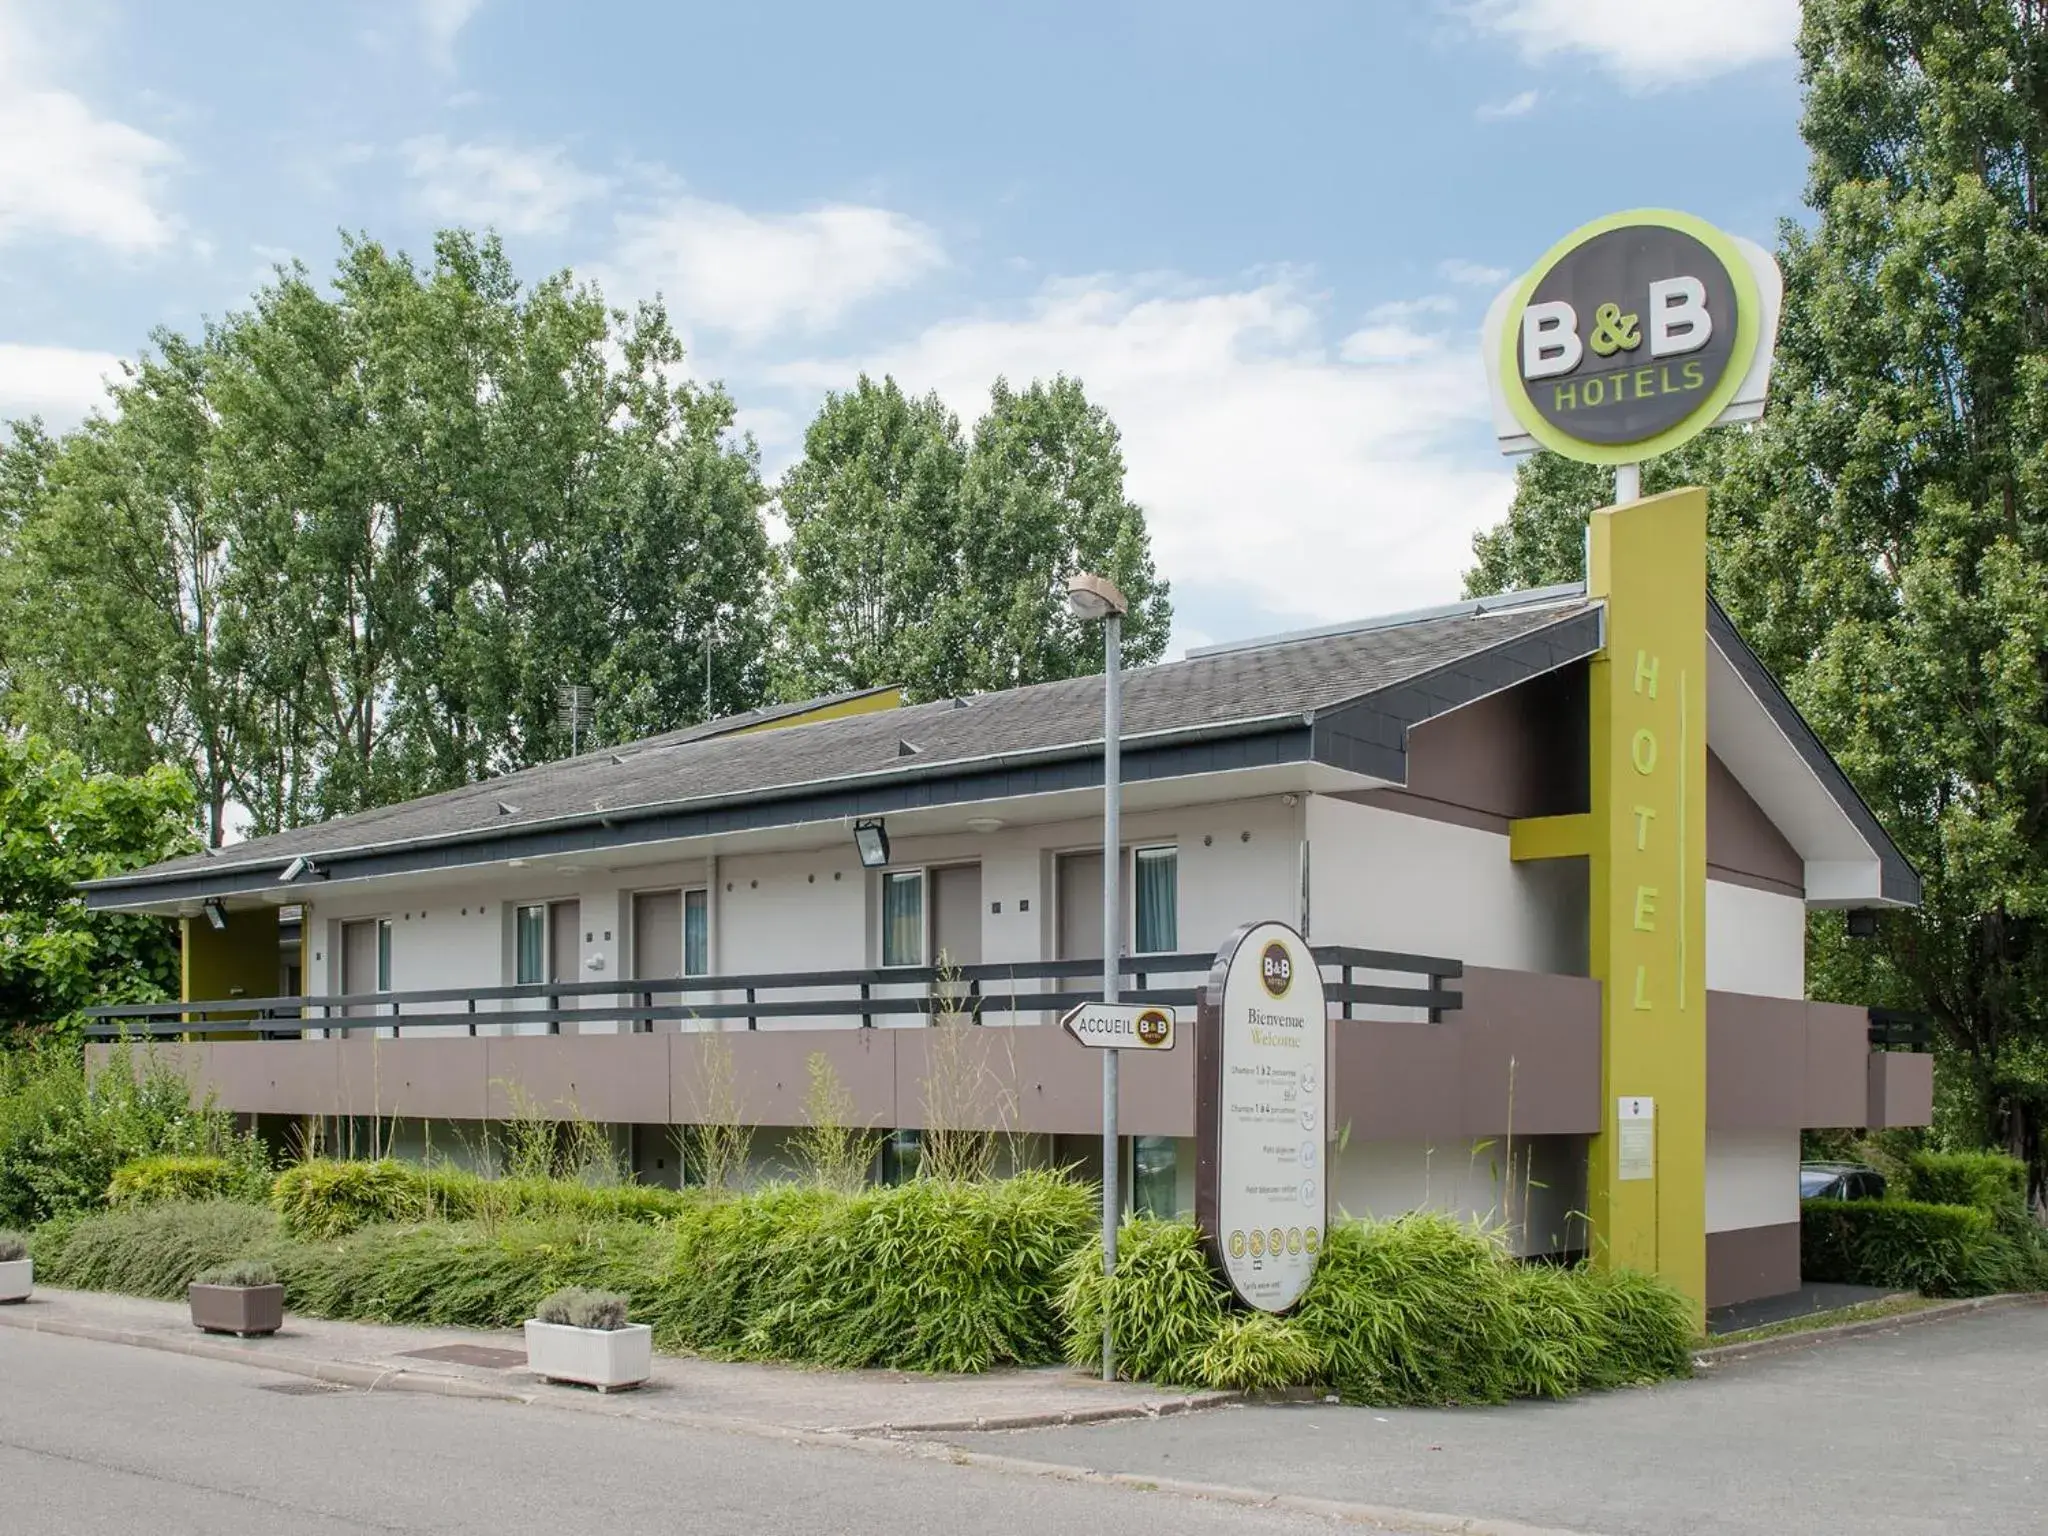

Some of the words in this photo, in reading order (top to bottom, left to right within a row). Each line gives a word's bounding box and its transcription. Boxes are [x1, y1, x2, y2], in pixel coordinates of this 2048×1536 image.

[1523, 276, 1713, 381] B&B
[1554, 361, 1704, 412] HOTELS
[1632, 648, 1660, 1011] HOTEL
[1264, 957, 1290, 979] B&B
[1079, 1018, 1134, 1035] ACCUEIL
[1140, 1020, 1167, 1034] B&B
[1247, 1008, 1305, 1029] Bienvenue
[1251, 1027, 1301, 1049] Welcome
